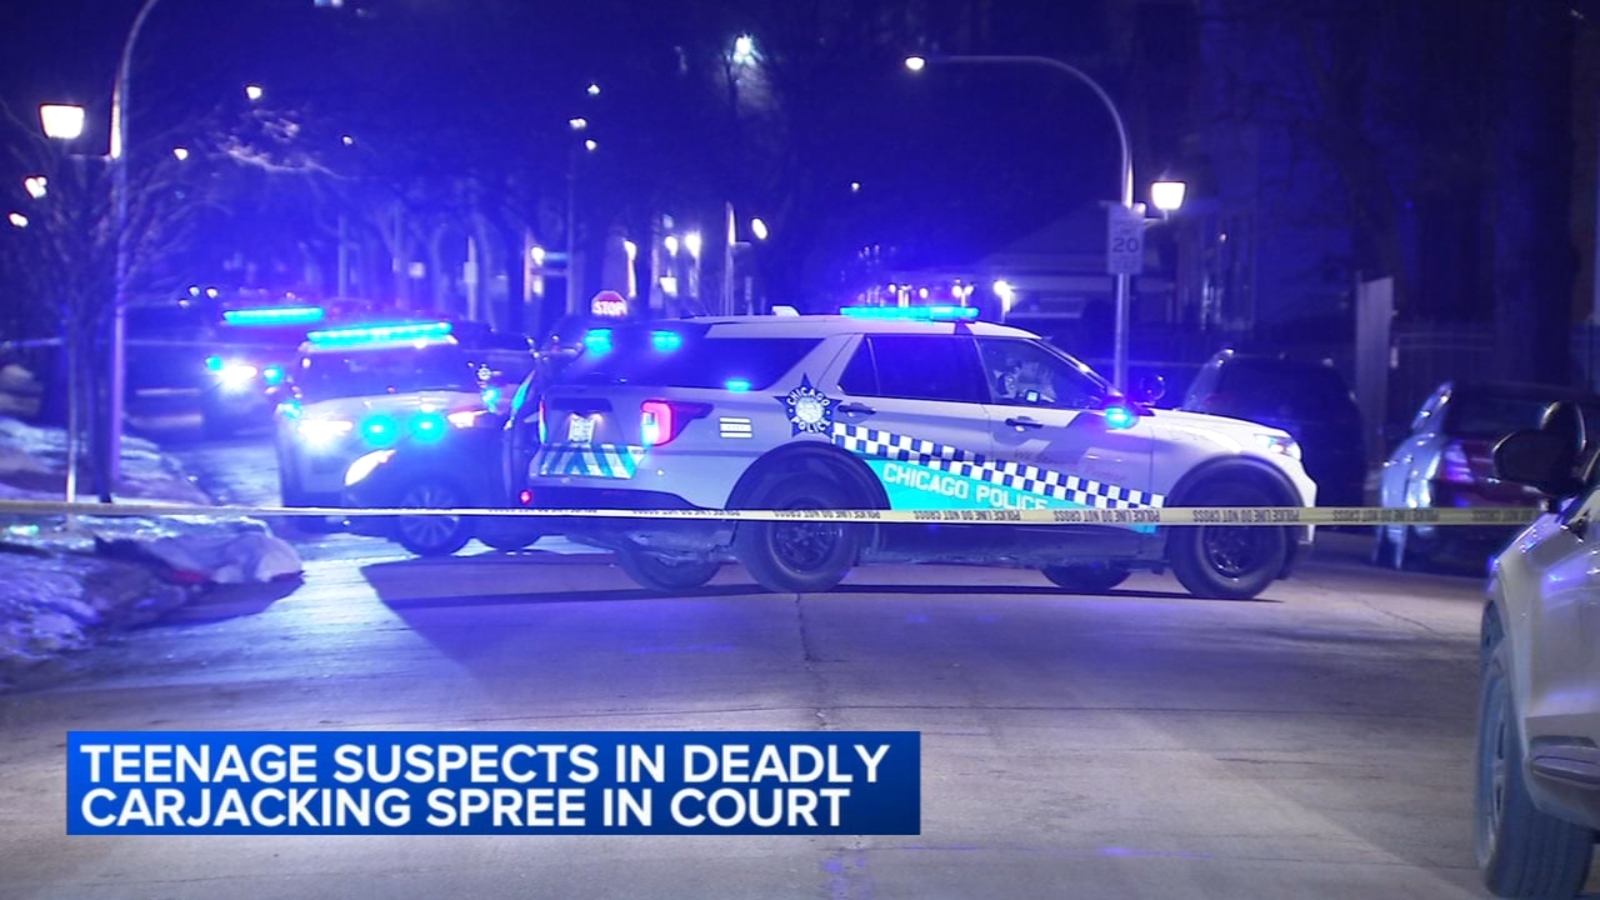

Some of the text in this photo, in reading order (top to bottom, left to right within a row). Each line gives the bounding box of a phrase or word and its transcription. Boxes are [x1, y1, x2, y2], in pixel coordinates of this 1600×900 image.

[1111, 237, 1140, 253] 20
[594, 300, 627, 316] STOP
[785, 386, 831, 406] CHICAGO
[790, 415, 831, 433] POLICE
[883, 462, 1048, 511] CHICAGO POLICE
[1053, 510, 1161, 523] POLICE LINE DO NOT CROSS
[1193, 510, 1300, 522] POLICE LINE DO NOT CROSS
